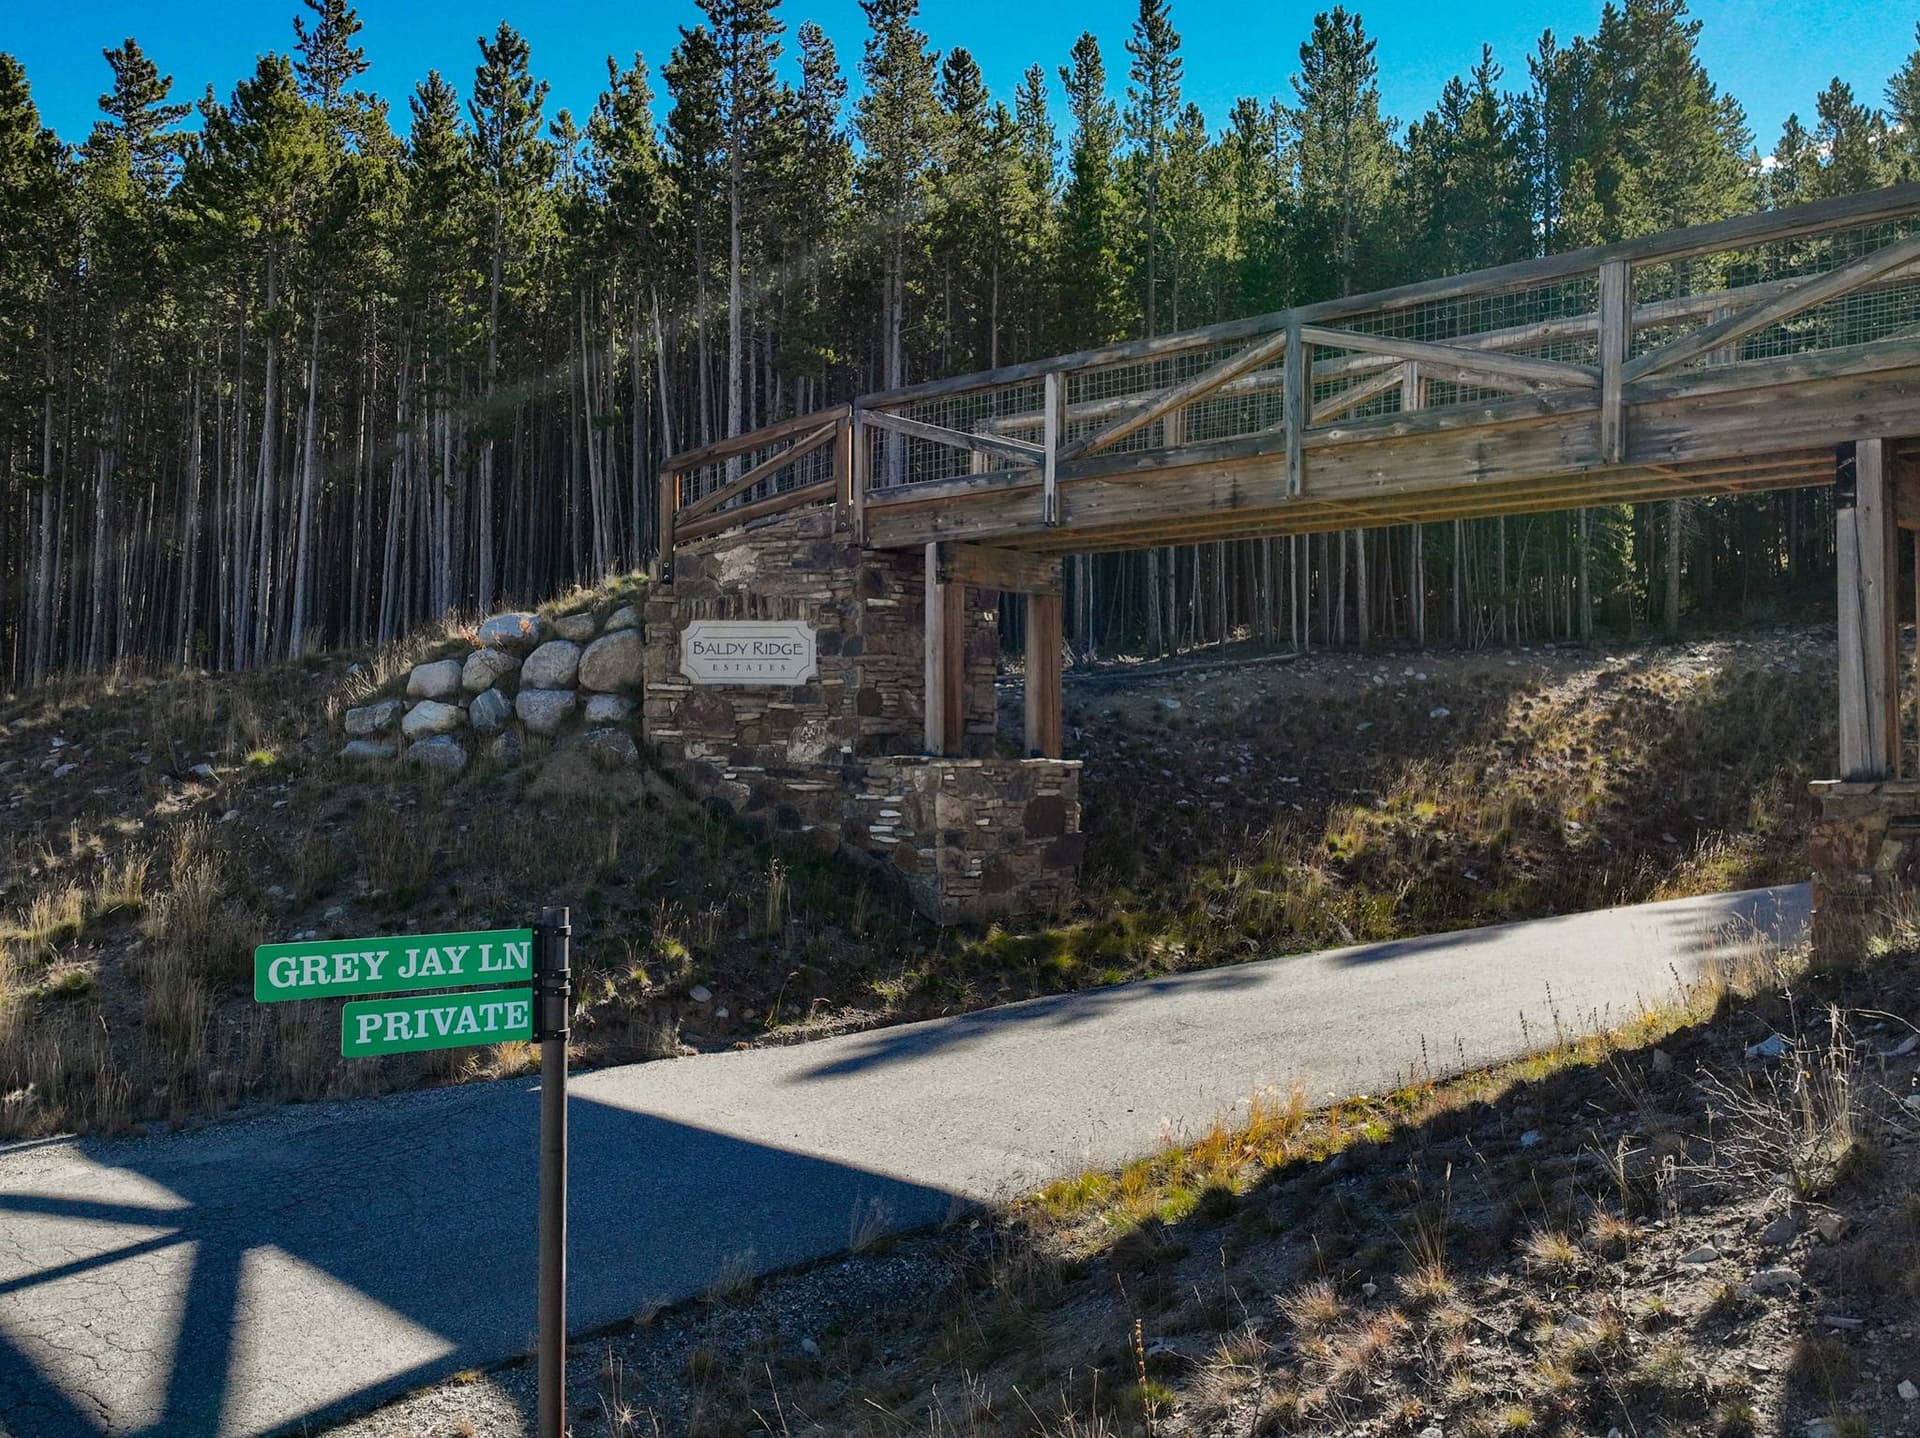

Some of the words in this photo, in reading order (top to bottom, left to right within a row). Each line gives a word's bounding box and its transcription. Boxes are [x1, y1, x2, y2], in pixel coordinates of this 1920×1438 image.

[693, 641, 748, 655] BALDY
[753, 641, 804, 655] RIDGE
[712, 663, 786, 671] ESTATES
[268, 950, 389, 988] GREY
[398, 945, 471, 978] JAY
[478, 941, 531, 973] LN
[355, 1000, 528, 1044] PRIVATE
